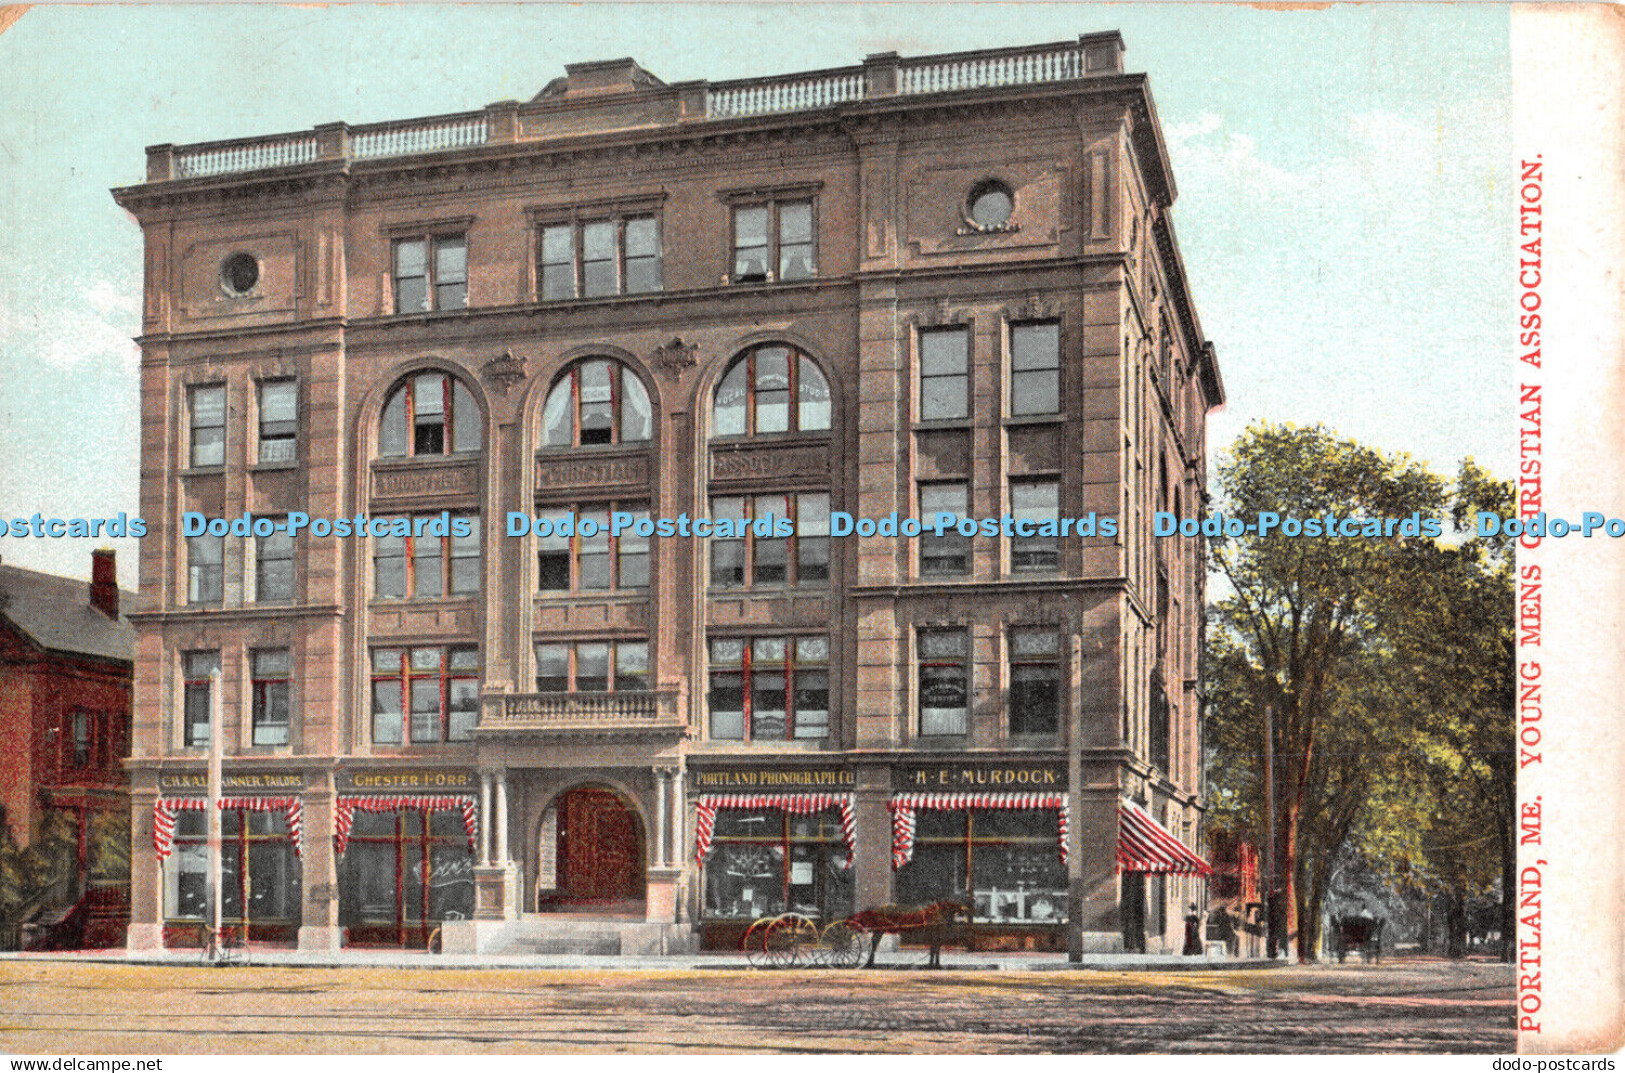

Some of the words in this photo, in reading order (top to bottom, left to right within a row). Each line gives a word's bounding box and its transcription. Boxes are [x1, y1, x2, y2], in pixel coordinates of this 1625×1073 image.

[354, 774, 418, 787] CHESTER
[435, 773, 467, 786] ORR
[696, 771, 757, 785] PORTLAND
[760, 771, 836, 785] PHONOGRAPH
[961, 769, 1055, 784] MURDOCK
